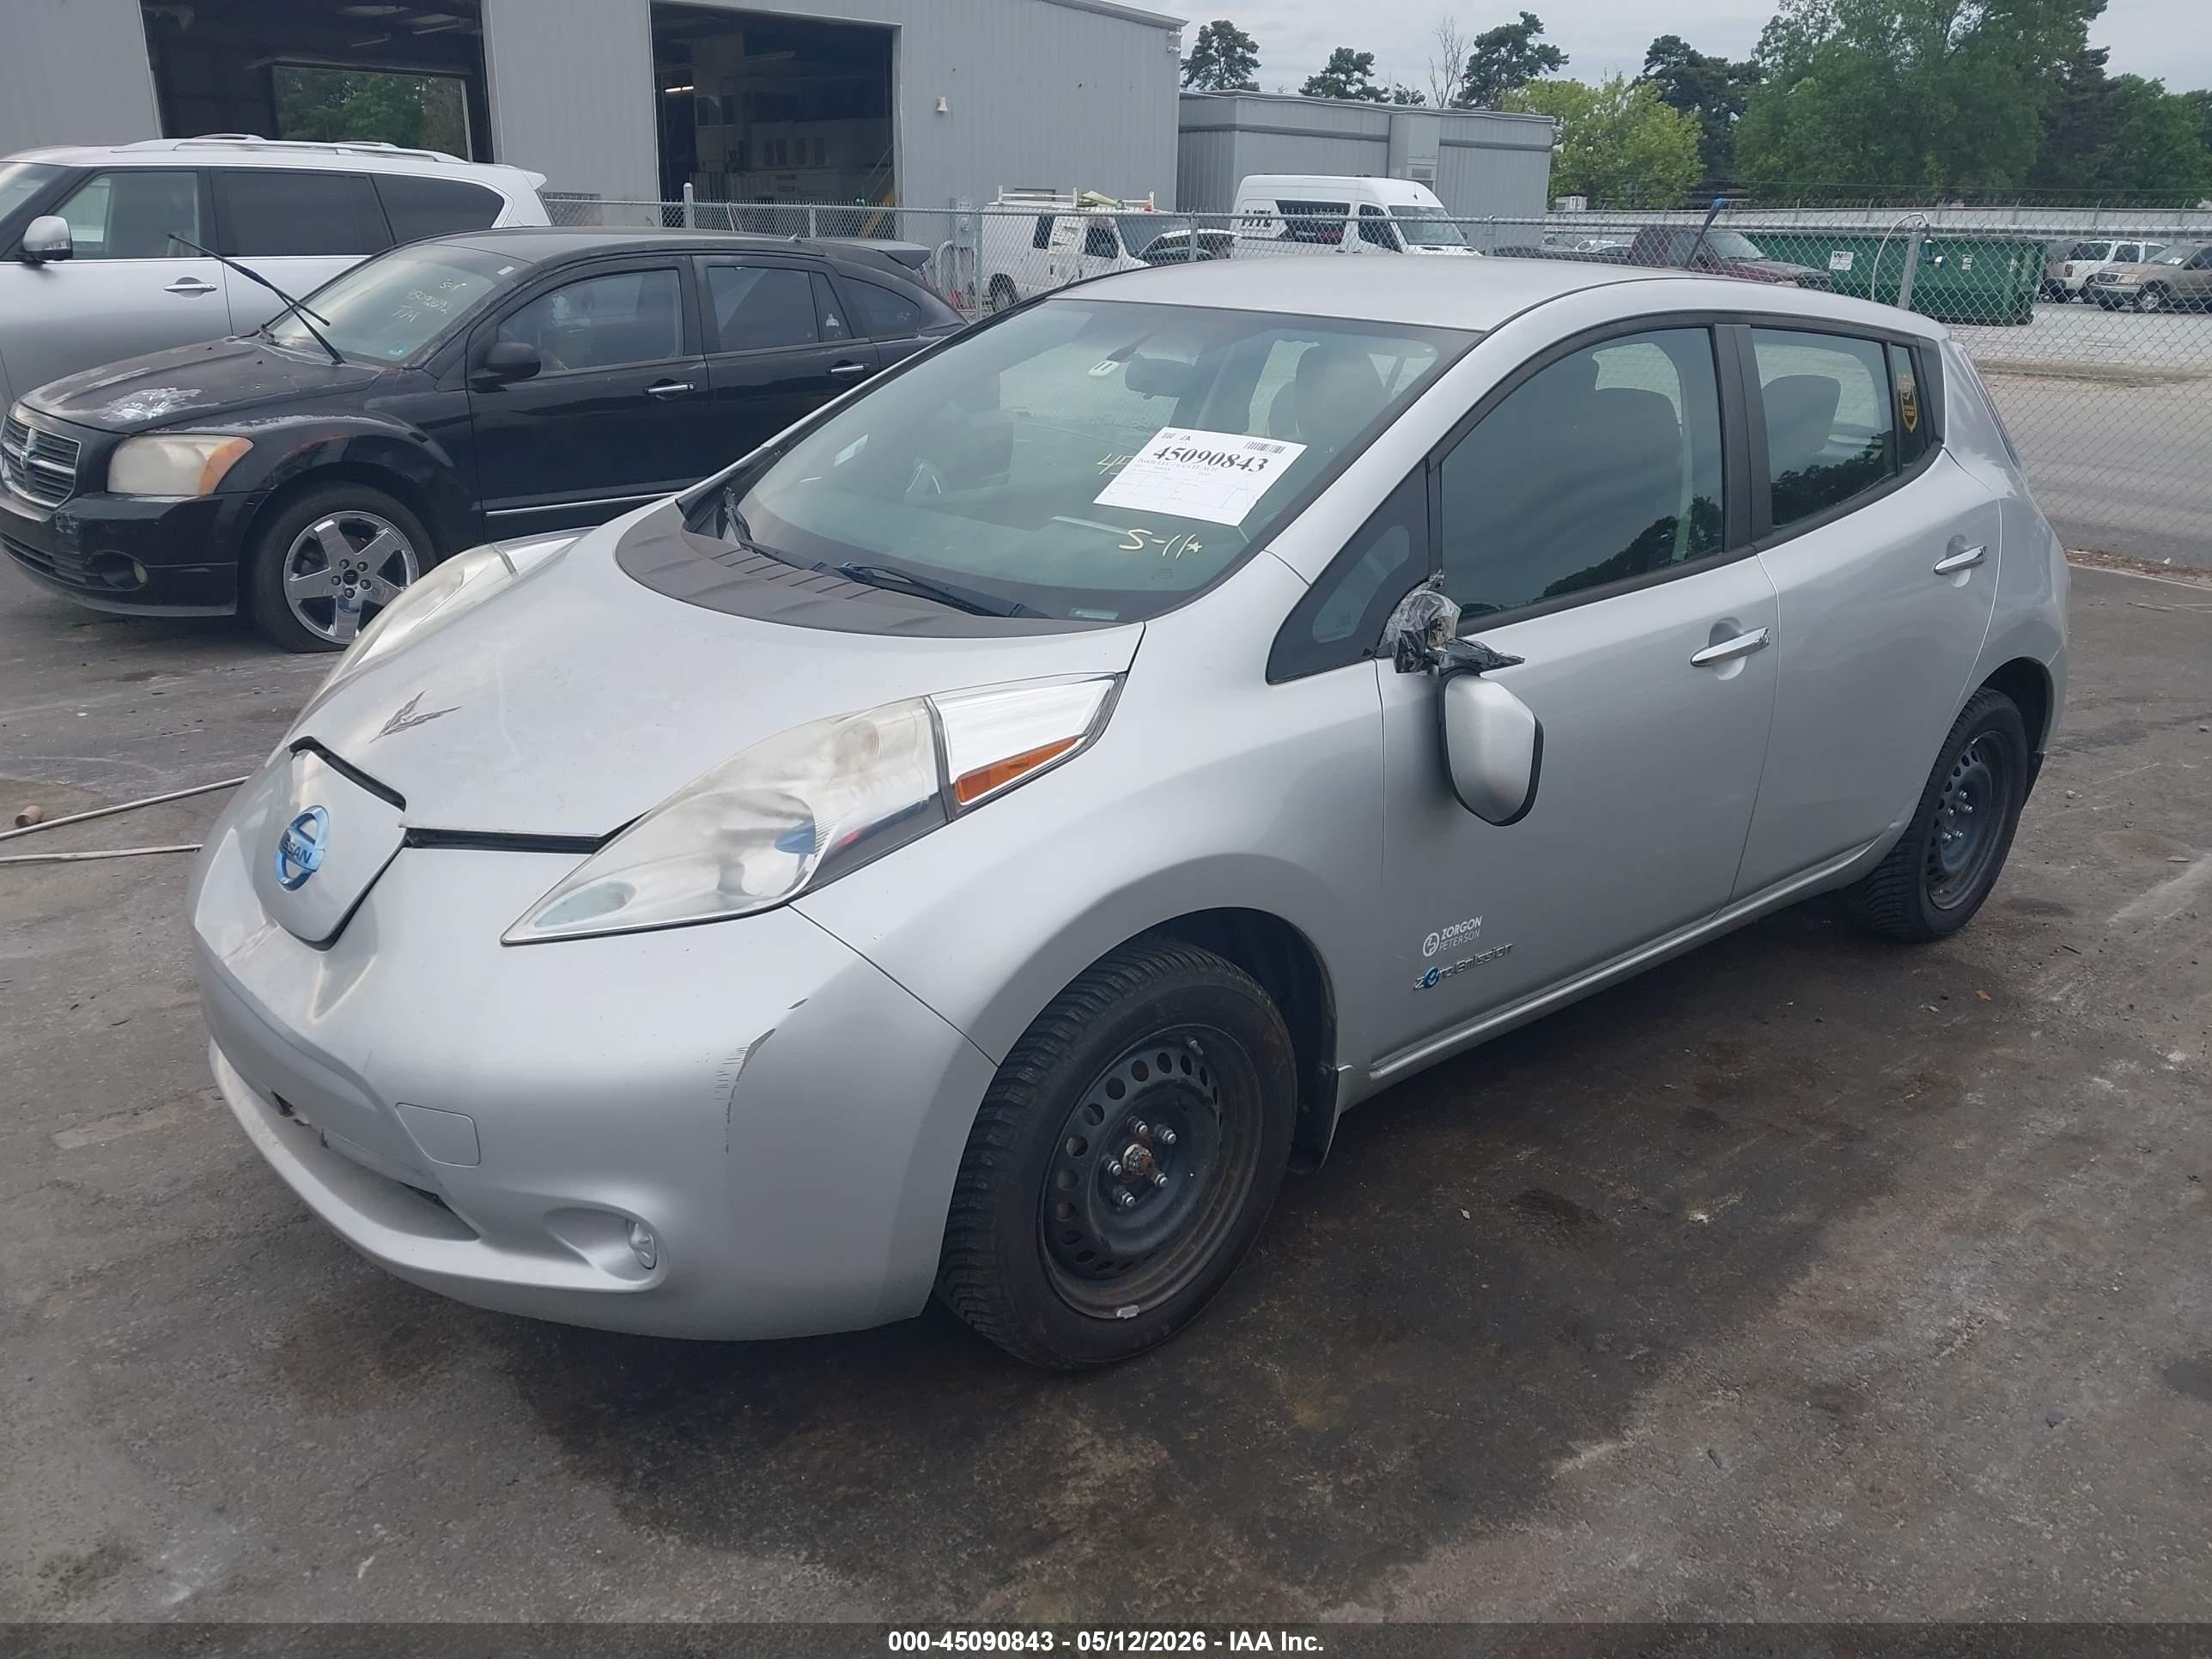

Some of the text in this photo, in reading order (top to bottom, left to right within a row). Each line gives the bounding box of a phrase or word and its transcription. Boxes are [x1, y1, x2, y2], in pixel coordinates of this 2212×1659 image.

[1152, 446, 1269, 472] 45090843
[1438, 929, 1480, 951] PETERSON
[1441, 915, 1483, 941] ZORGON
